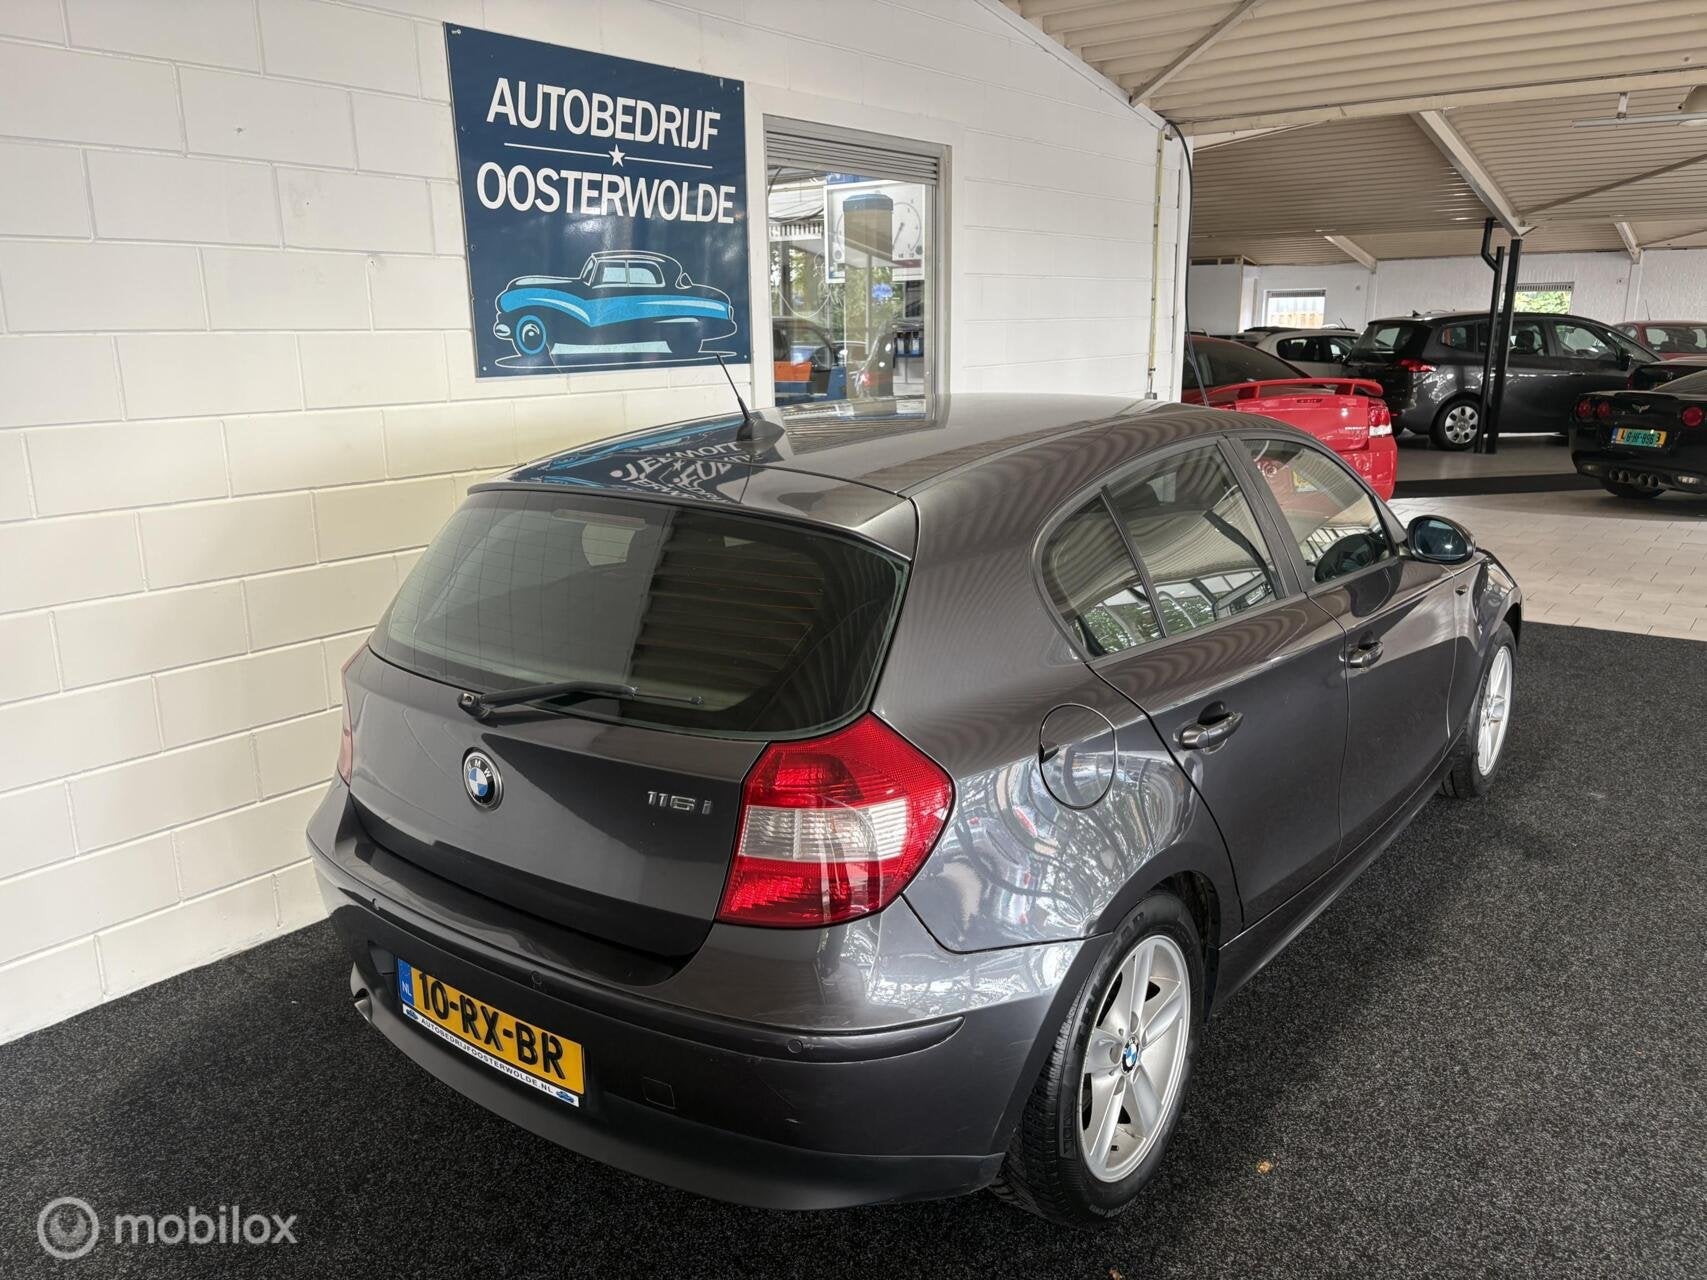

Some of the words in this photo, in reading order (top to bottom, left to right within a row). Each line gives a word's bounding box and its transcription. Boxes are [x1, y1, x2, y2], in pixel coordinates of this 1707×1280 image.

[486, 77, 721, 151] AUTOBEDRIJF
[475, 161, 736, 225] OOSTERWOLDE
[401, 980, 413, 997] NL
[419, 972, 566, 1080] 10-RX-BR
